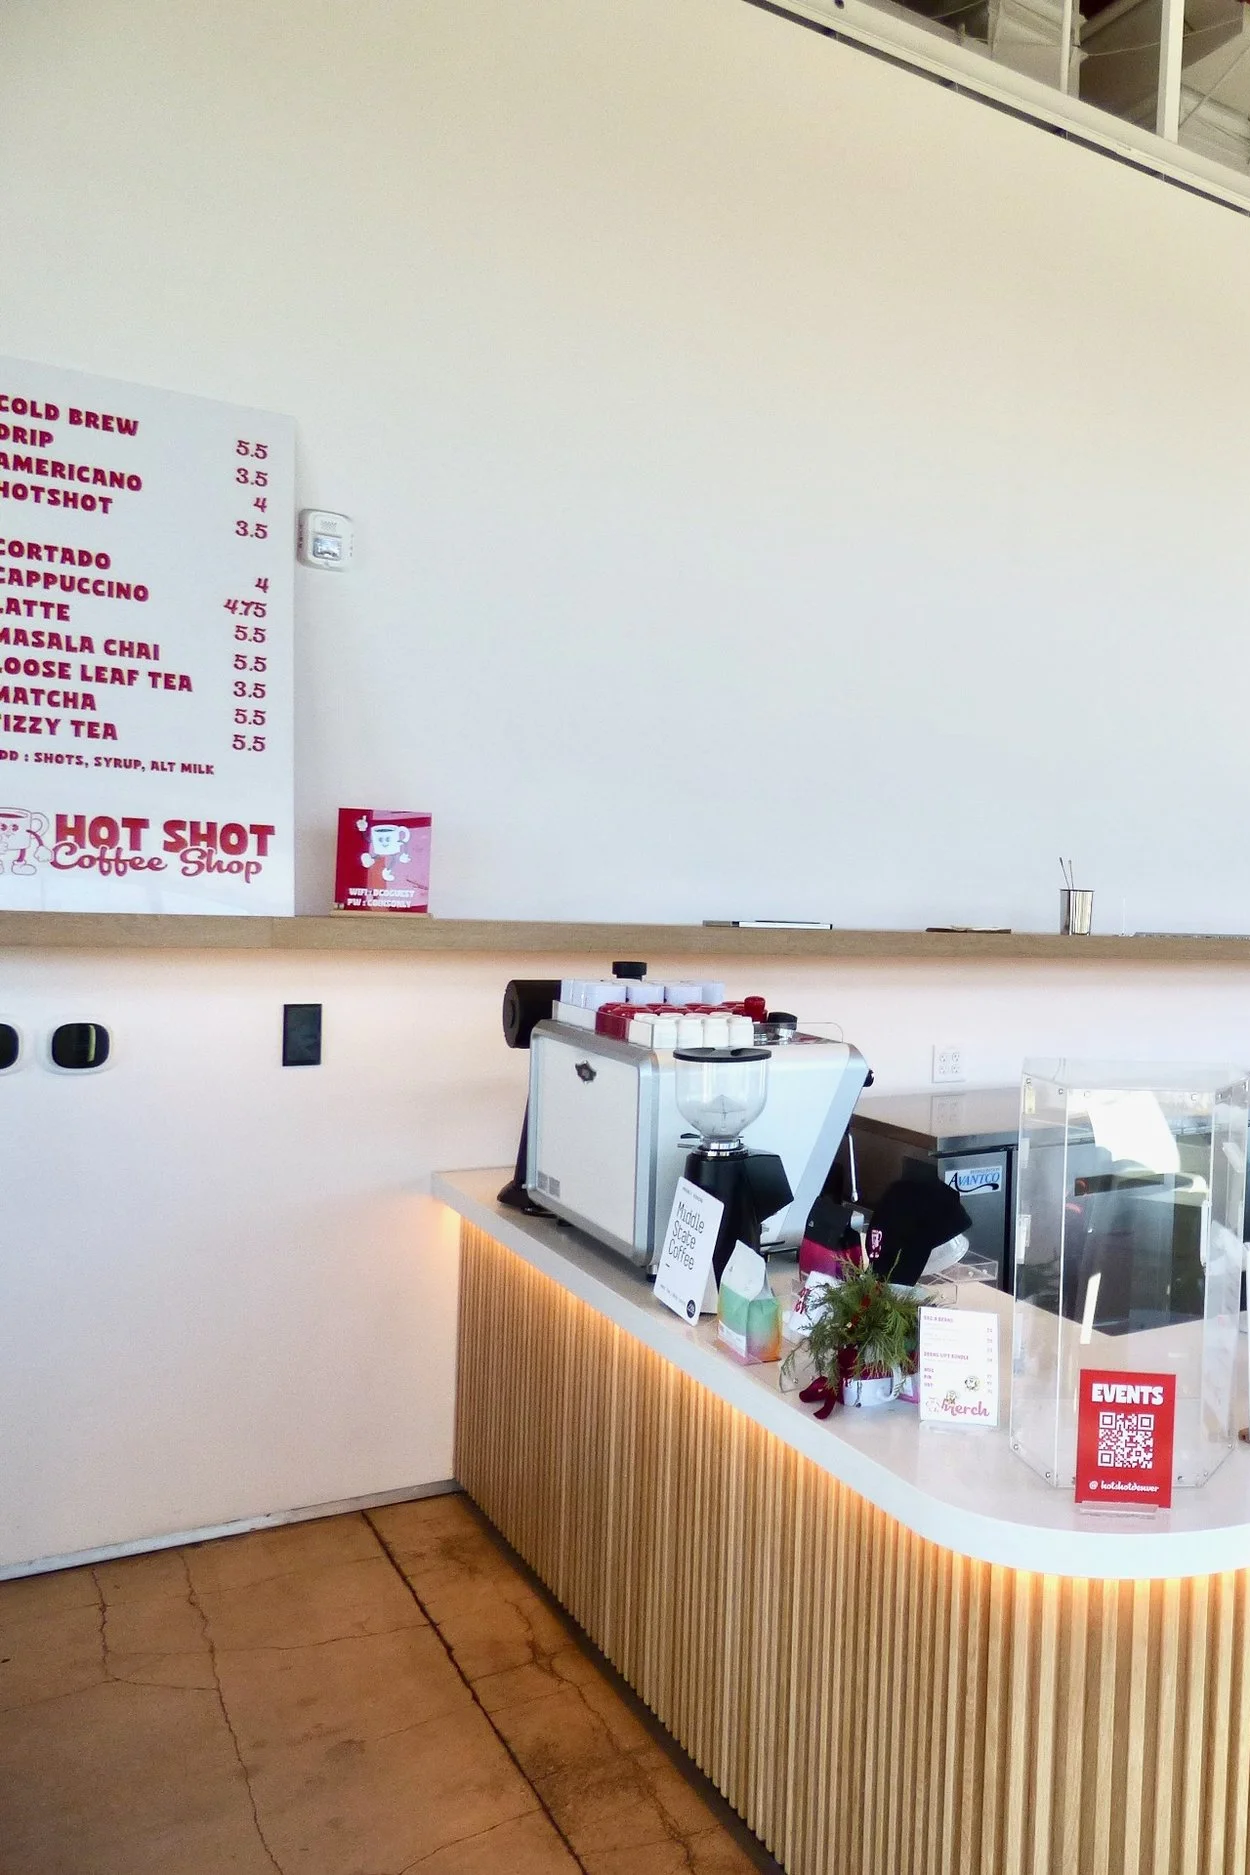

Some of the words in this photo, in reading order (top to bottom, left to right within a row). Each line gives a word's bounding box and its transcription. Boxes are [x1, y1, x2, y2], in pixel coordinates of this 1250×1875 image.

[68, 408, 140, 437] BREW
[0, 422, 54, 448] DRIP
[235, 440, 269, 460] 5.5
[0, 451, 142, 492] AMERICANO
[235, 468, 269, 488] 3.5
[253, 497, 268, 514] 4
[235, 520, 269, 540] 3.5
[254, 576, 269, 593] 4
[0, 597, 70, 621] ATTE
[224, 599, 268, 619] 4.75
[234, 624, 267, 644] 5.5
[103, 638, 160, 660] CHAI
[0, 656, 71, 680] OOSE
[80, 664, 139, 688] LEAF
[147, 670, 194, 693] TEA
[233, 653, 267, 673] 5.5
[233, 680, 267, 700] 3.5
[0, 714, 62, 736] IZZY
[71, 719, 118, 740] TEA
[233, 707, 267, 727] 5.5
[232, 733, 266, 753] 5.5
[34, 752, 89, 768] SHOTS,
[94, 756, 146, 772] SYRUP,
[150, 760, 176, 774] ALT
[180, 763, 215, 776] MILK
[55, 813, 150, 852] HOT
[162, 818, 276, 857] SHOT
[50, 842, 168, 877] Coffee
[180, 847, 263, 884] Shop
[675, 1201, 705, 1234] Middle
[672, 1219, 697, 1250] State
[668, 1238, 695, 1271] Coffee
[1091, 1383, 1164, 1406] EVENTS
